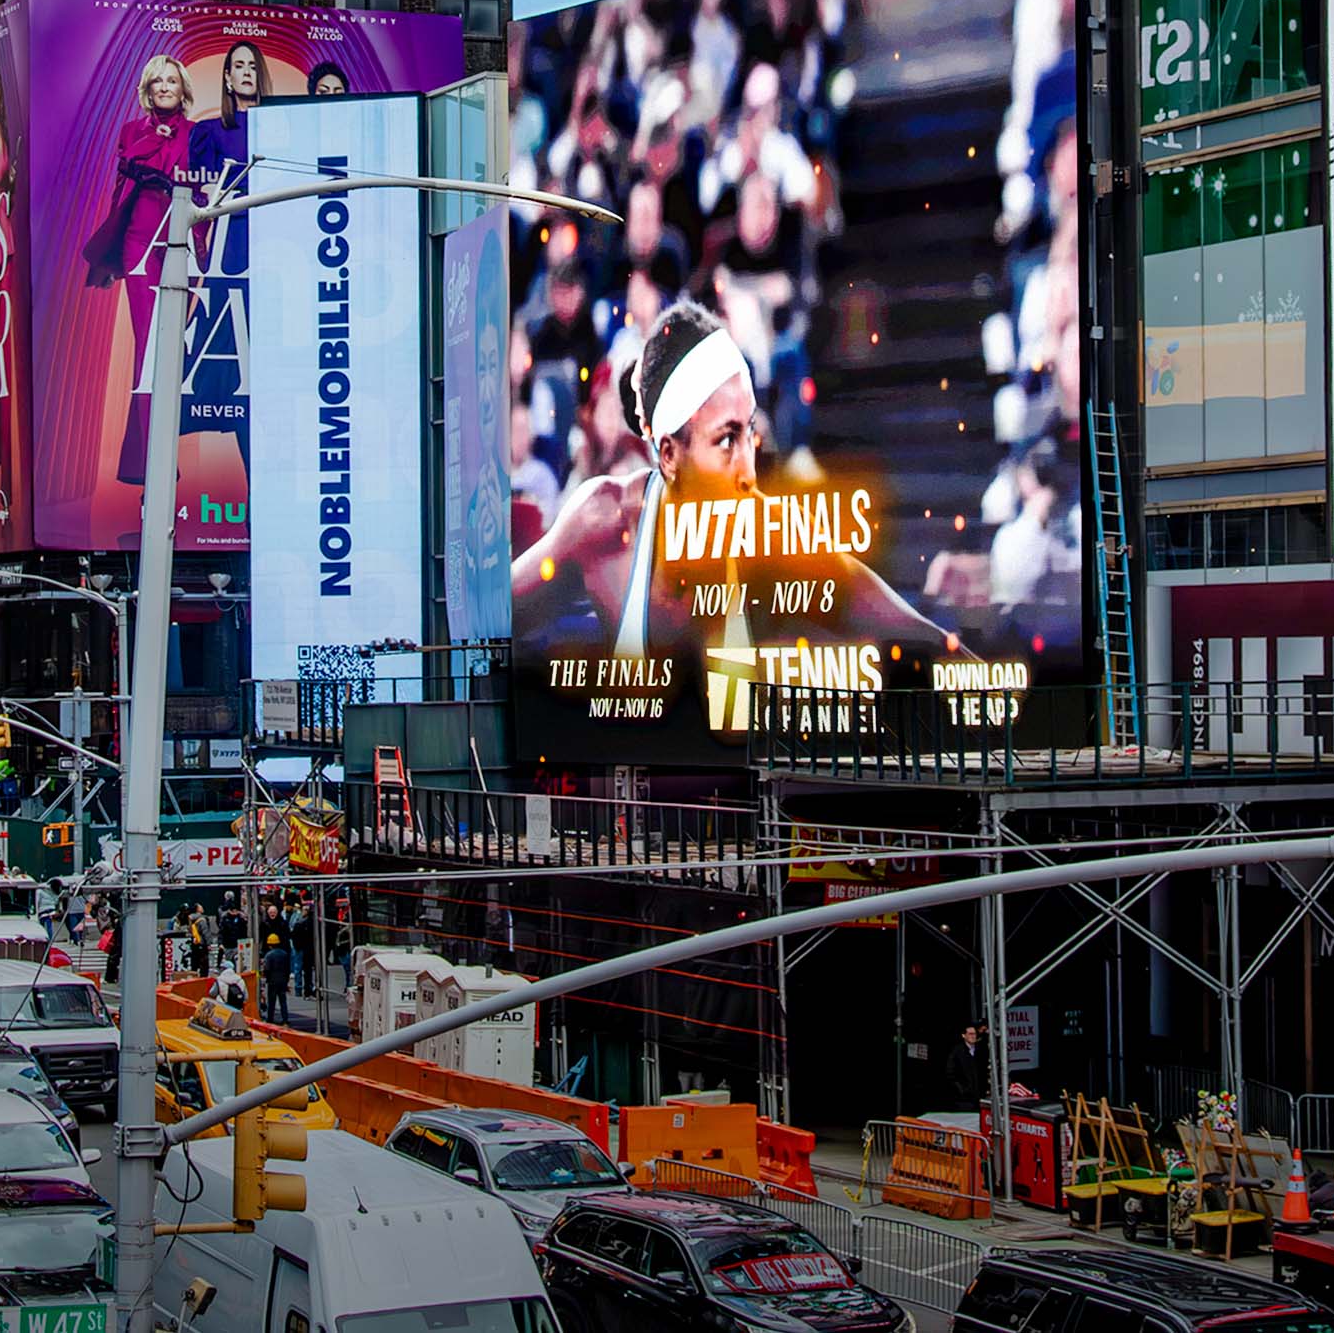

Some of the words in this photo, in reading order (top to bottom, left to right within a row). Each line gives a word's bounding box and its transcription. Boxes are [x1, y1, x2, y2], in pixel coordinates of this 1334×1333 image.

[95, 0, 129, 9] FROM
[137, 3, 210, 15] EXECUTIVE
[217, 8, 284, 19] PRODUCER
[293, 12, 330, 21] RYAN
[340, 15, 397, 26] MURPHY
[151, 23, 183, 33] CLOSE
[153, 17, 180, 26] GLENN
[232, 21, 259, 30] SARAH
[223, 27, 267, 37] PAULSON
[307, 32, 344, 42] TAYLOR
[310, 26, 340, 35] TEYANA
[174, 166, 219, 182] hulu
[317, 156, 353, 596] NOBLEMOBILE.COM
[191, 405, 245, 418] NEVER
[178, 506, 188, 520] 4
[665, 498, 757, 562] WTA
[763, 489, 872, 556] FINALS
[692, 582, 733, 616] NOV
[737, 584, 748, 615] 1
[771, 580, 813, 614] NOV
[820, 580, 835, 612] 8
[549, 659, 588, 687] THE
[597, 658, 673, 687] FINALS
[758, 645, 882, 702] TENNIS
[933, 663, 1027, 691] DOWNLOAD
[589, 698, 613, 718] NOV
[614, 698, 649, 717] 1-NOV
[650, 697, 663, 718] 16
[828, 884, 845, 899] BIG
[1016, 1122, 1049, 1138] CHARTS.
[28, 1313, 47, 1333] W
[54, 1312, 83, 1333] 47
[87, 1311, 103, 1331] St
